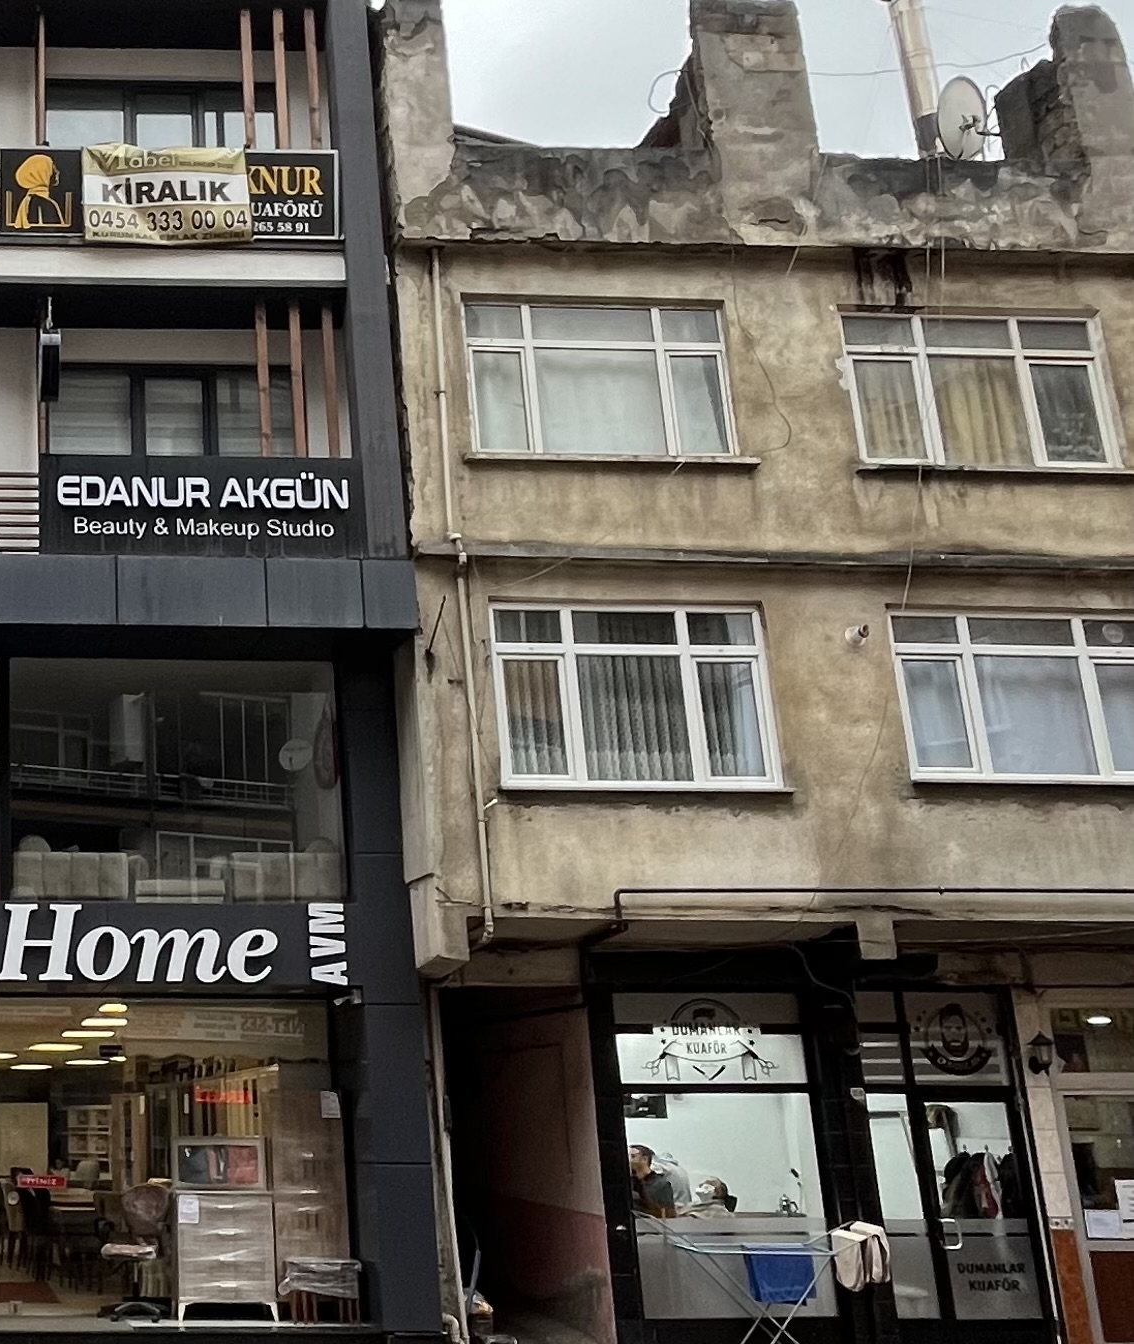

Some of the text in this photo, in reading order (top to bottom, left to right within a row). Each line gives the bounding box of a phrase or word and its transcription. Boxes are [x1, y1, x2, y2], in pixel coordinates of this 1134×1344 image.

[102, 177, 231, 205] KİRALIK
[89, 209, 248, 231] 0454 333 00 04
[277, 222, 293, 233] 58
[295, 222, 310, 233] 91
[57, 471, 350, 510] EDANUR AKGÜN
[74, 517, 147, 540] Beauty
[153, 518, 169, 536] &
[176, 518, 260, 540] Makeup
[308, 903, 349, 986] AVM
[686, 1040, 727, 1055] KUAFÖR
[957, 1263, 1026, 1274] DUMANLAR
[969, 1278, 1022, 1292] KUAFÖR
